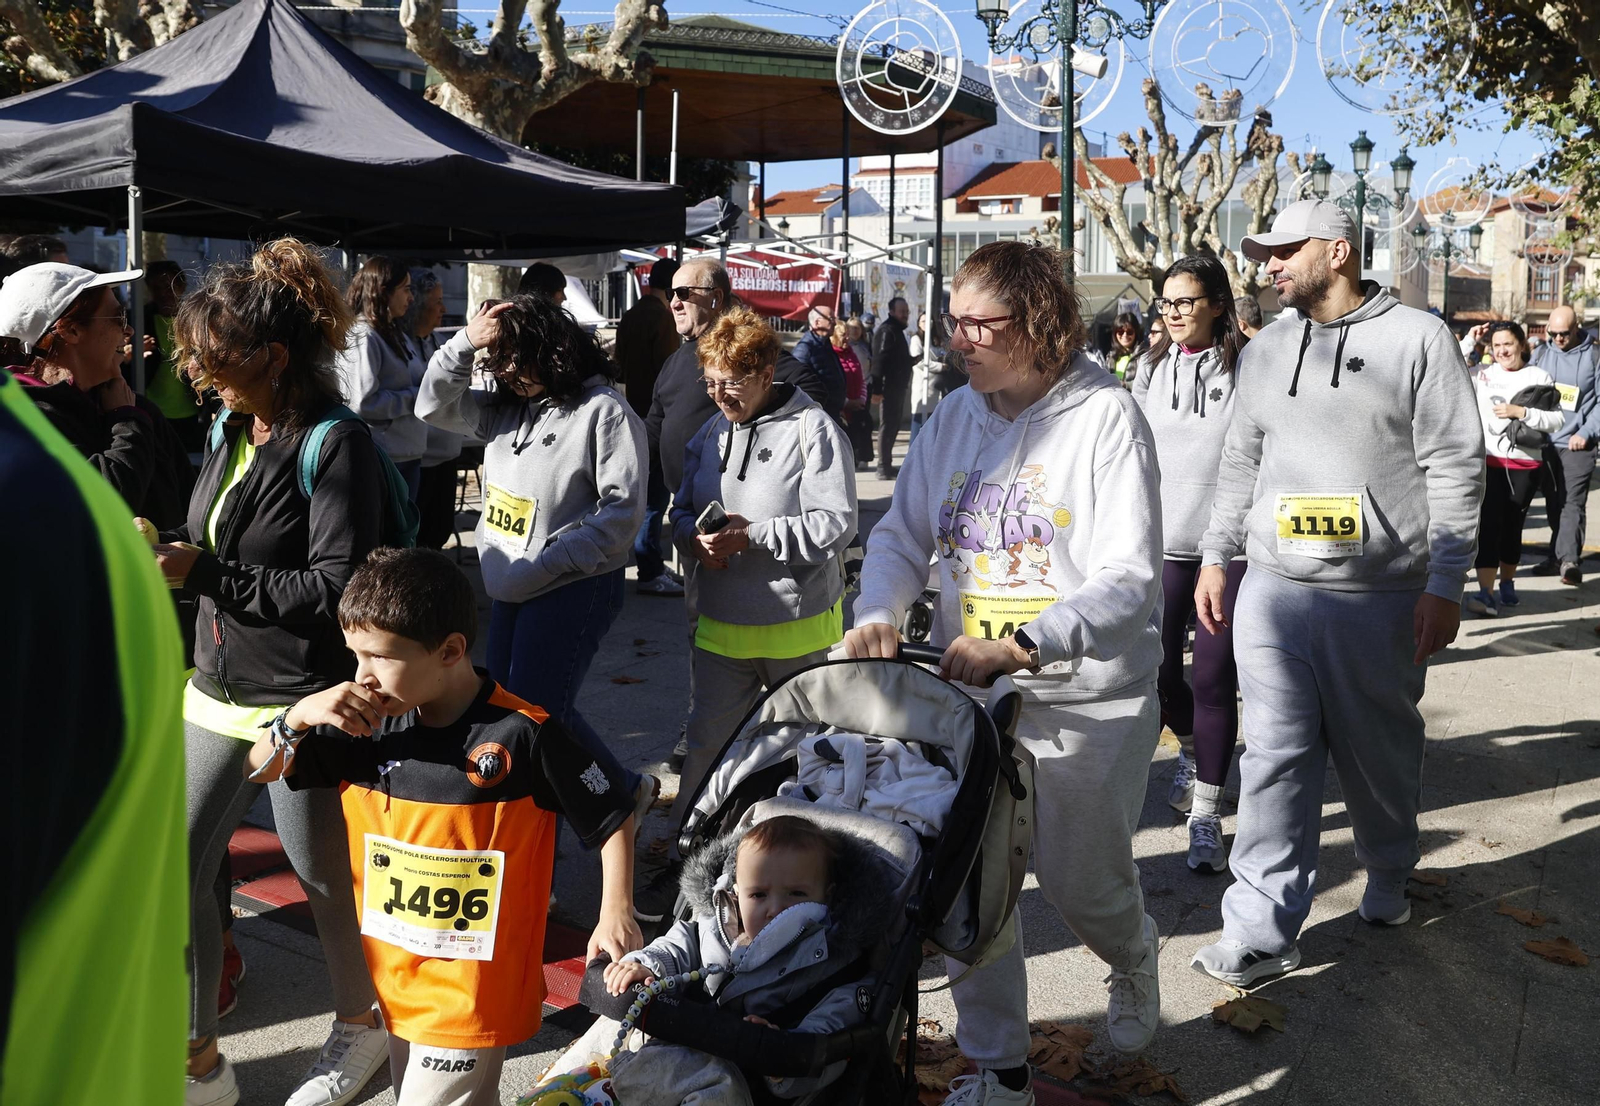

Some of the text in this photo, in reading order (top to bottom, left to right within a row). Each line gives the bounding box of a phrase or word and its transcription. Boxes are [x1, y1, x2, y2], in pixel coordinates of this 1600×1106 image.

[732, 278, 788, 292] ESCLEROSE
[486, 505, 526, 536] 1194
[1290, 516, 1356, 536] 1119
[404, 849, 420, 859] POLA
[420, 854, 459, 863] ESCLEROSE
[418, 870, 441, 878] COSTAS
[389, 876, 489, 921] 1496
[421, 1056, 477, 1073] STARS
